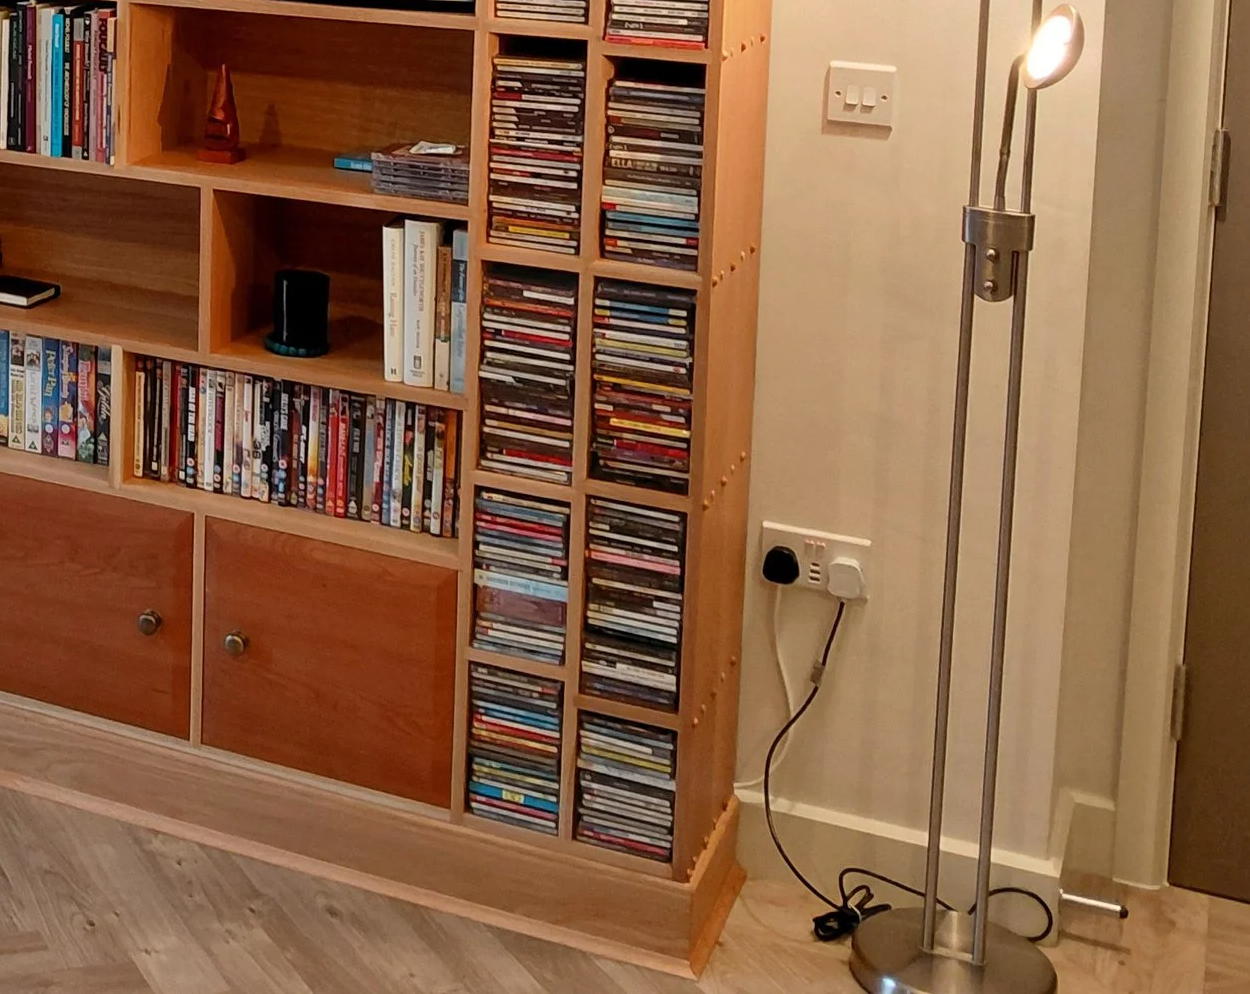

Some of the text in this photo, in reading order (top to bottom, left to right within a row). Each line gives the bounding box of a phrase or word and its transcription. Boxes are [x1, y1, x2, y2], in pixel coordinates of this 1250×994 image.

[99, 18, 107, 73] FOUCAULT
[612, 159, 633, 169] ELLA
[44, 350, 56, 398] Peter Pan
[253, 441, 261, 459] 36
